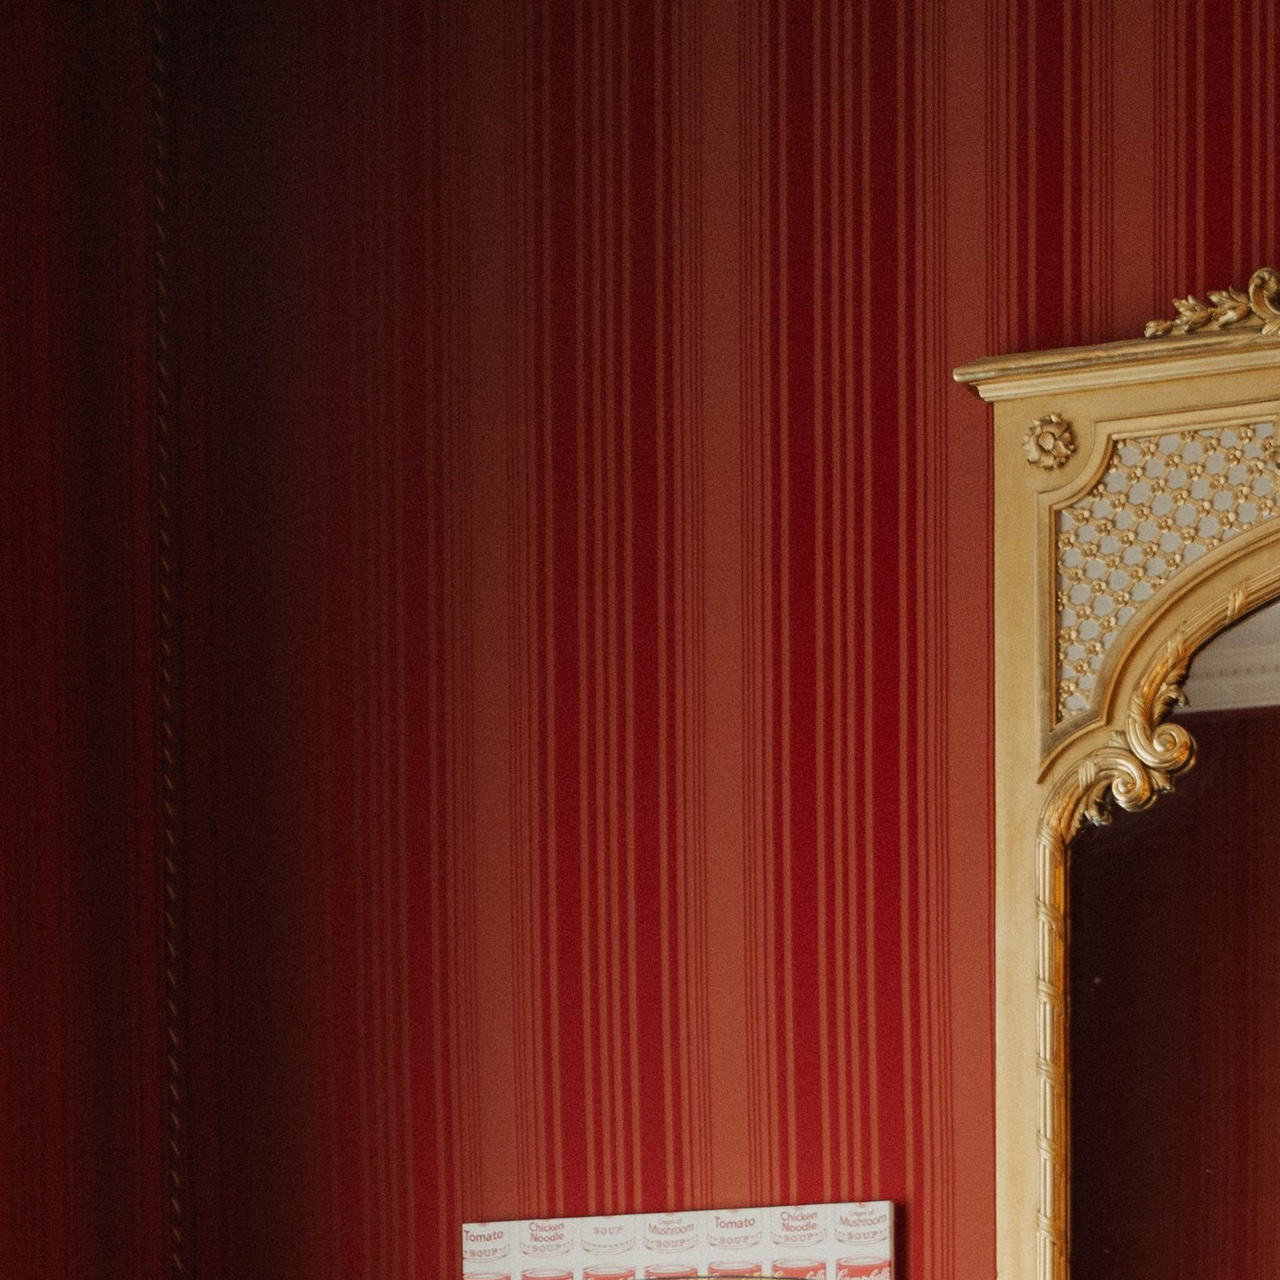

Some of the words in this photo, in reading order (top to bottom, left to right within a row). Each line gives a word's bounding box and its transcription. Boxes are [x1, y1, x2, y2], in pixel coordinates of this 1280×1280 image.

[780, 1211, 817, 1221] Chicken
[839, 1213, 887, 1227] Mushroom
[529, 1222, 564, 1232] Chicken
[714, 1216, 755, 1229] Tomato
[782, 1221, 816, 1232] Noodle
[593, 1226, 623, 1235] SOUP
[649, 1222, 694, 1235] Mushroom
[464, 1230, 503, 1242] Tomato
[530, 1232, 564, 1243] Noodle
